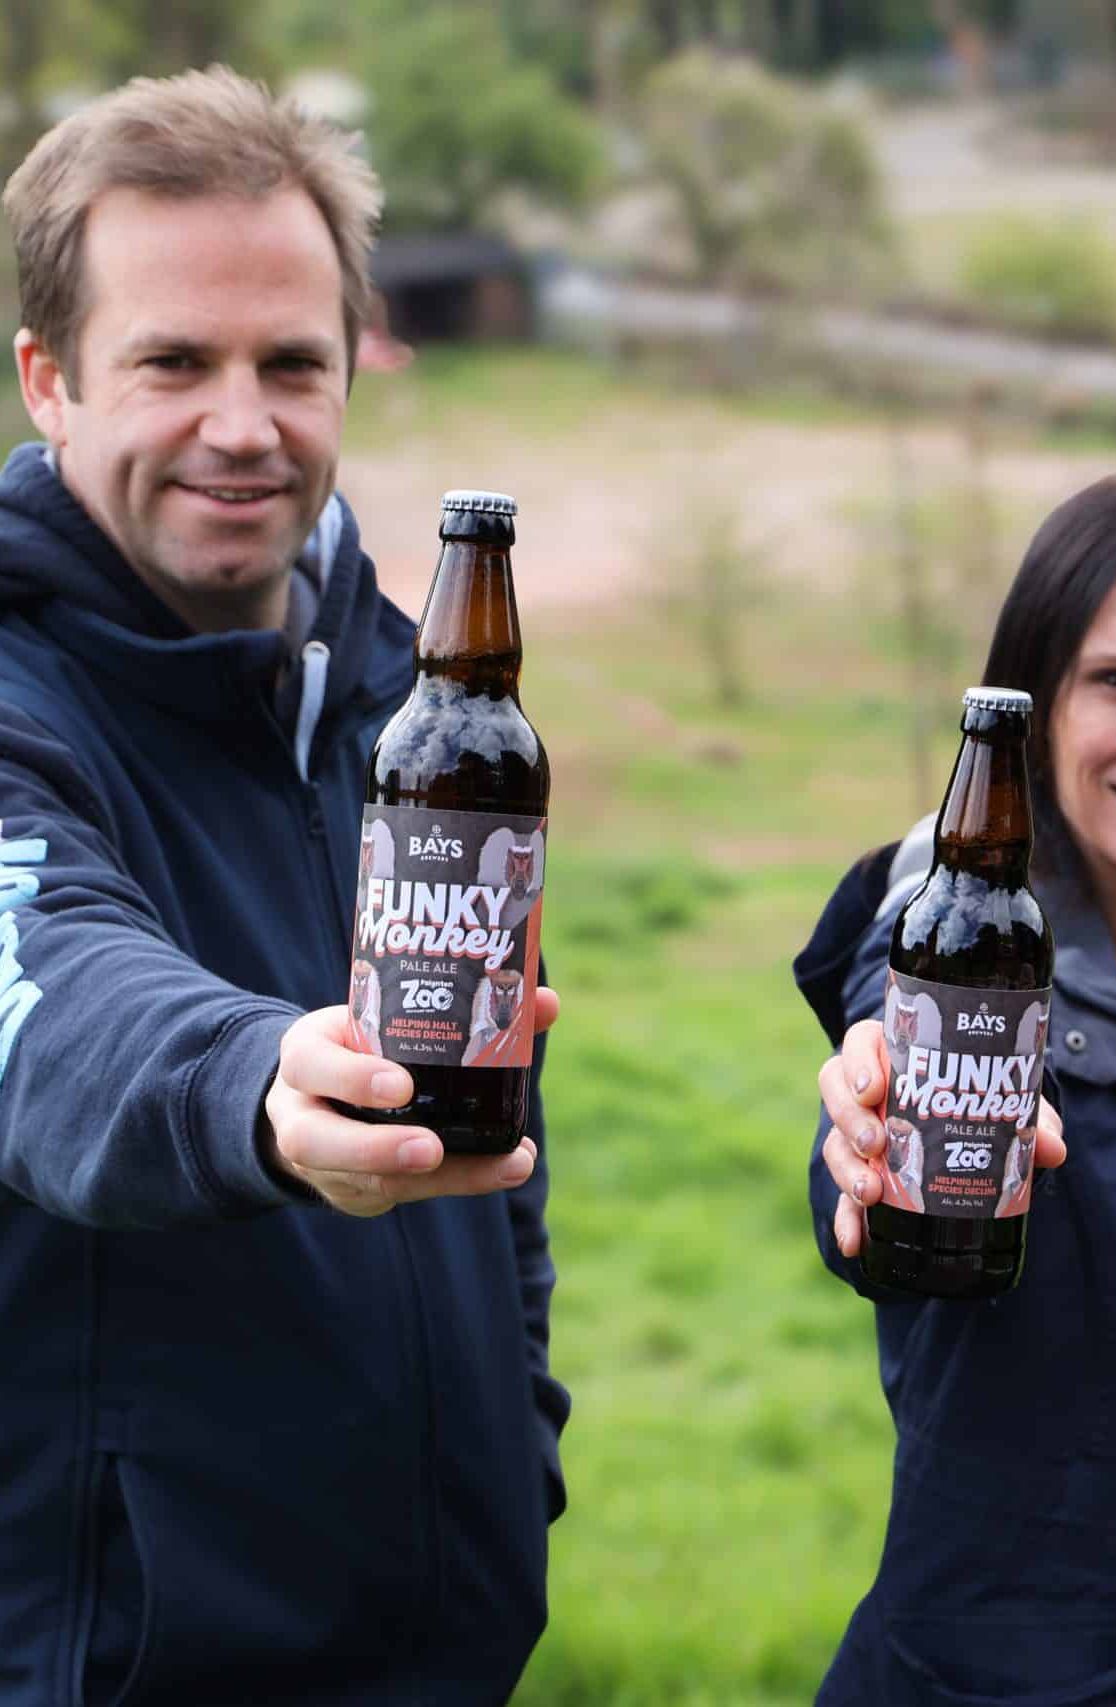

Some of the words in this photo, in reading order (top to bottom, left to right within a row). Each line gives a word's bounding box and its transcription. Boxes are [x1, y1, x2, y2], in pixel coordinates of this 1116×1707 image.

[409, 836, 462, 858] BAYS
[367, 879, 511, 928] FUNKY
[359, 909, 514, 973] Monkey
[400, 960, 430, 972] PALE
[433, 963, 458, 974] ALE
[386, 1027, 421, 1038] SPECIES
[391, 1018, 430, 1028] HELPING
[432, 1020, 457, 1030] HALT
[957, 1012, 1006, 1032] BAYS
[908, 1045, 1036, 1092] FUNKY
[896, 1074, 1035, 1130] Monkey
[945, 1123, 973, 1136] PALE
[975, 1126, 996, 1137] ALE
